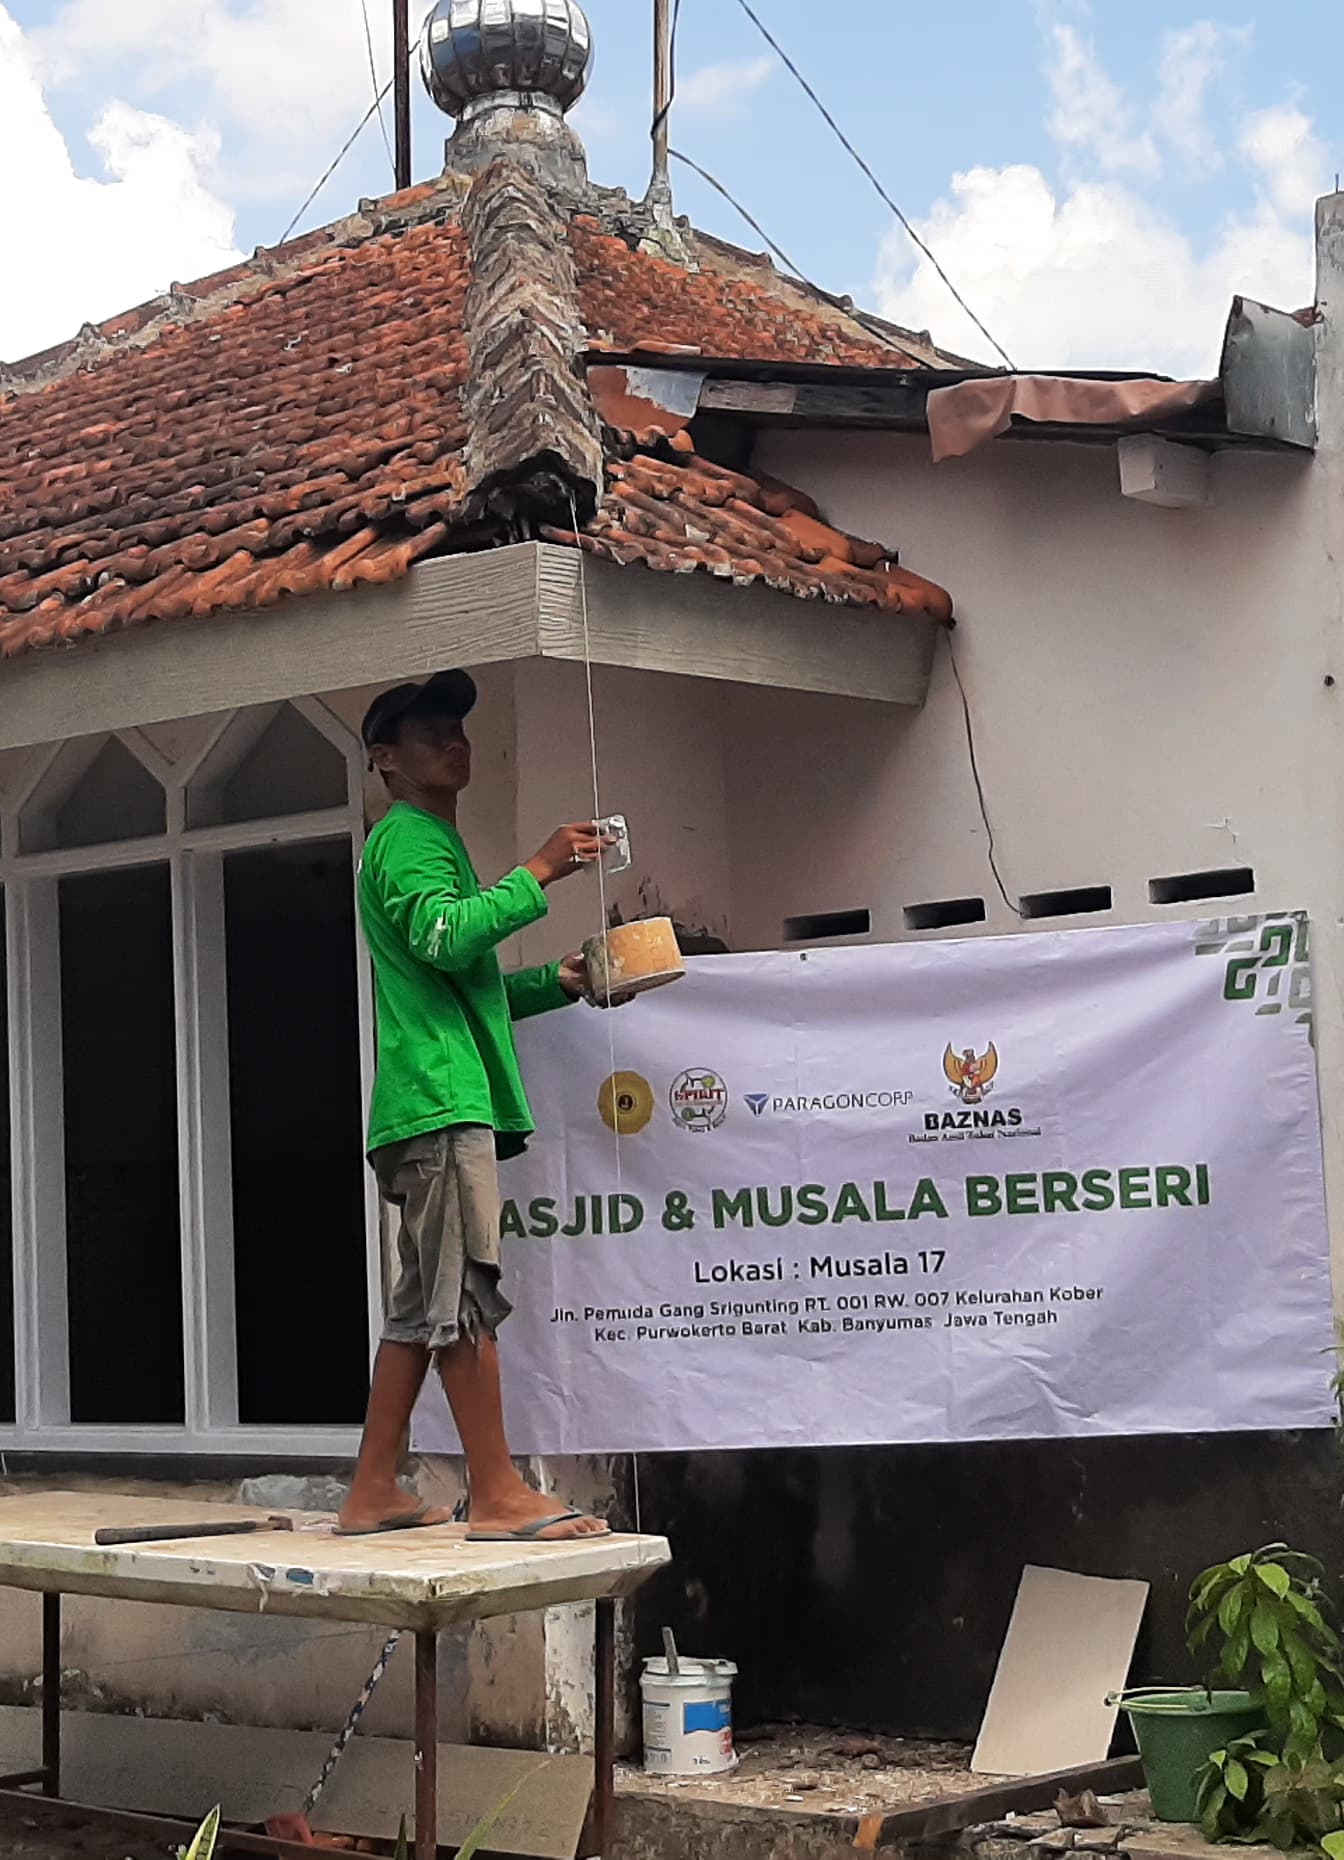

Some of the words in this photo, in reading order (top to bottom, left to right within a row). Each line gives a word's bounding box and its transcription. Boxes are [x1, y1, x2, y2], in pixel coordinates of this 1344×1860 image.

[772, 1091, 913, 1112] PARAGONCORP
[923, 1107, 1022, 1131] BAZNAS
[499, 1193, 644, 1239] ASJID
[661, 1190, 695, 1232] &
[712, 1178, 949, 1229] MUSALA
[965, 1163, 1211, 1217] BERSERI
[694, 1257, 783, 1283] Lokasi
[793, 1261, 800, 1280] :
[810, 1252, 908, 1279] Musala
[917, 1251, 946, 1273] 17
[583, 1304, 654, 1321] Pemuda
[659, 1303, 704, 1319] Gang
[710, 1298, 799, 1318] Srigunting
[837, 1294, 868, 1309] 001
[914, 1291, 949, 1307] 007
[956, 1288, 1044, 1305] Kelurahan
[1049, 1286, 1104, 1301] Kober
[636, 1322, 736, 1340] Purwokerto
[944, 1312, 988, 1328] Jawa
[993, 1309, 1058, 1326] Tengah
